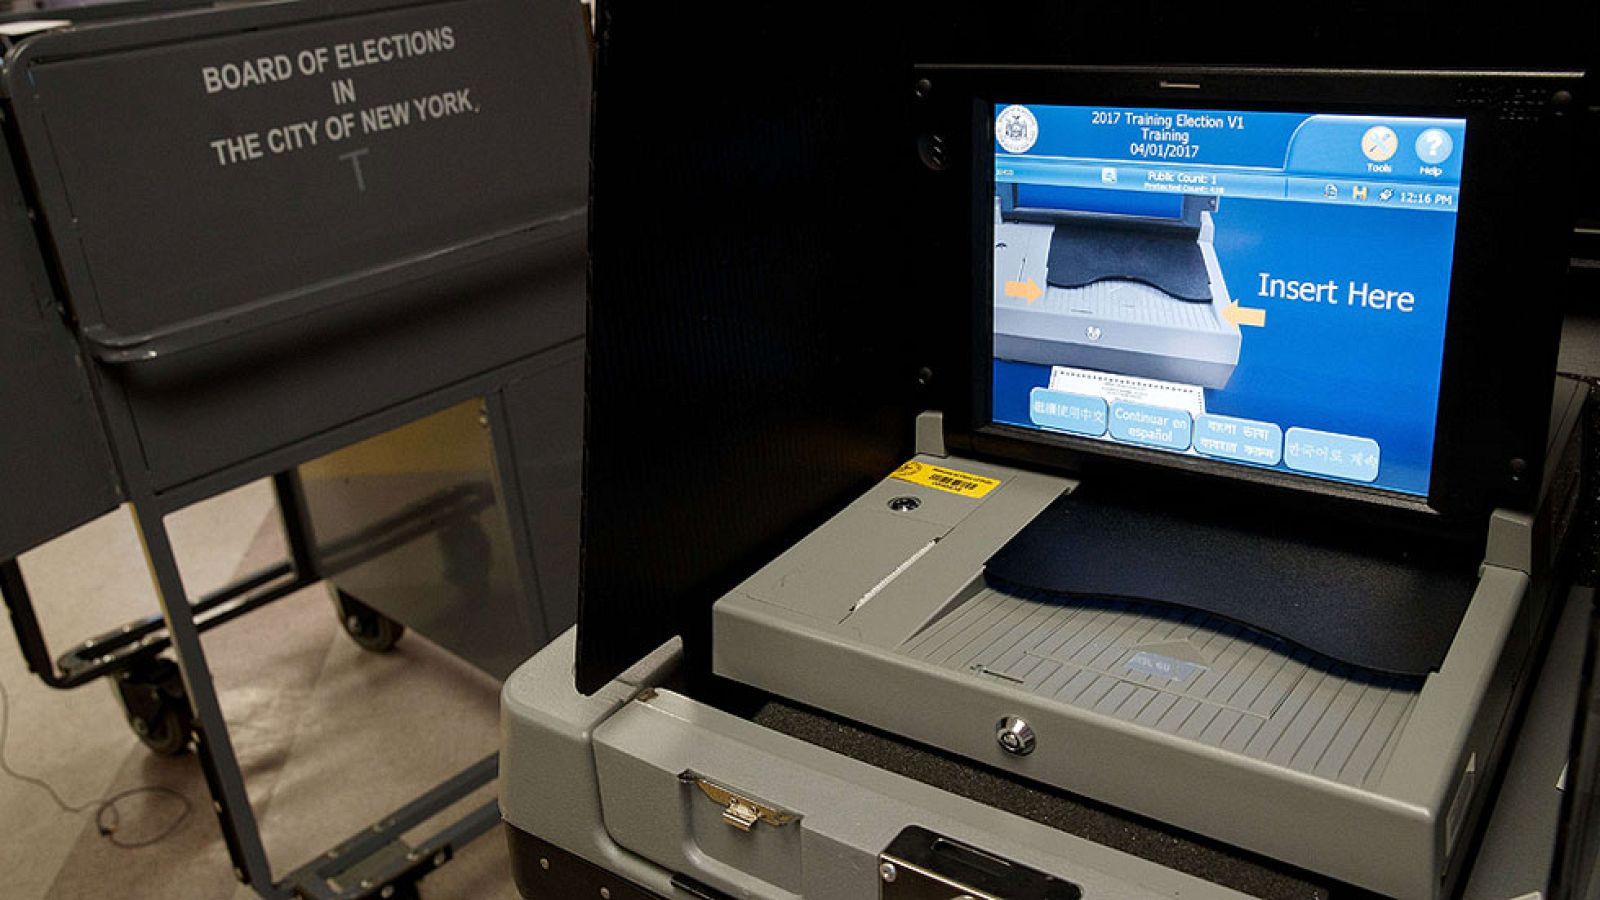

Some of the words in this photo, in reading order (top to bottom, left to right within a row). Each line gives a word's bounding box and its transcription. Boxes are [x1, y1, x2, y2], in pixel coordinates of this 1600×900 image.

[202, 55, 292, 93] BOARD
[298, 48, 329, 75] OF
[333, 26, 456, 69] ELECTIONS
[332, 79, 356, 105] IN
[1091, 111, 1121, 124] 2017
[1125, 112, 1172, 128] Training
[1176, 114, 1224, 128] Election
[1227, 115, 1245, 130] V1
[210, 133, 263, 165] THE
[267, 121, 318, 152] CITY
[325, 113, 355, 141] OF
[360, 102, 411, 134] NEW
[1140, 127, 1189, 144] Training
[1130, 143, 1200, 158] 04/01/2017
[1367, 163, 1392, 173] Tools
[1420, 166, 1442, 177] Help
[1148, 171, 1174, 182] Public
[1177, 172, 1208, 184] Count:
[1212, 175, 1217, 185] 1
[1400, 192, 1432, 204] 12:16
[1434, 194, 1452, 205] PM
[1258, 272, 1338, 305] Insert
[1348, 281, 1415, 312] Here
[1114, 407, 1168, 426] Continuar
[1172, 418, 1188, 430] en
[1128, 426, 1173, 442] español
